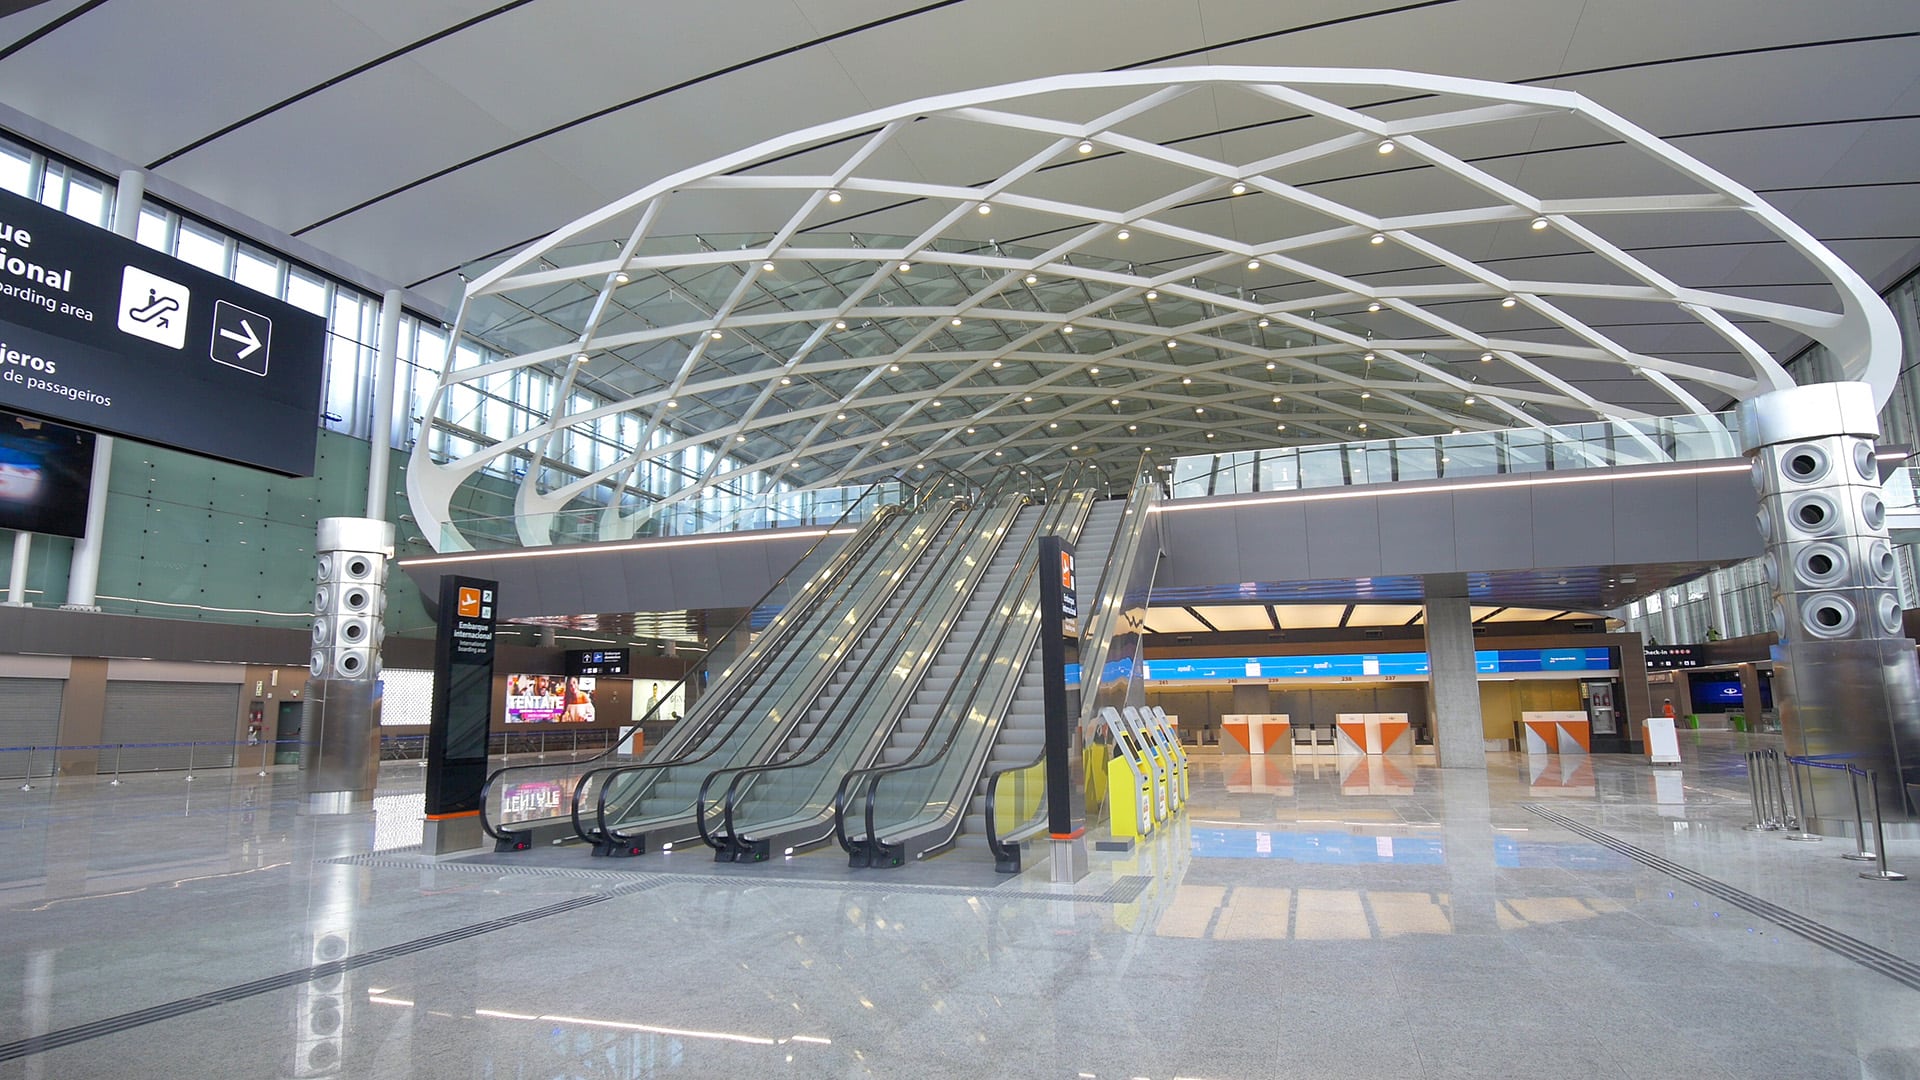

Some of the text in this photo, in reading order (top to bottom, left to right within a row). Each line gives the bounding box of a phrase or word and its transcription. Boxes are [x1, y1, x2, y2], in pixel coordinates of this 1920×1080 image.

[60, 302, 94, 322] area
[3, 369, 111, 406] de passageiros
[458, 621, 489, 633] Embarque
